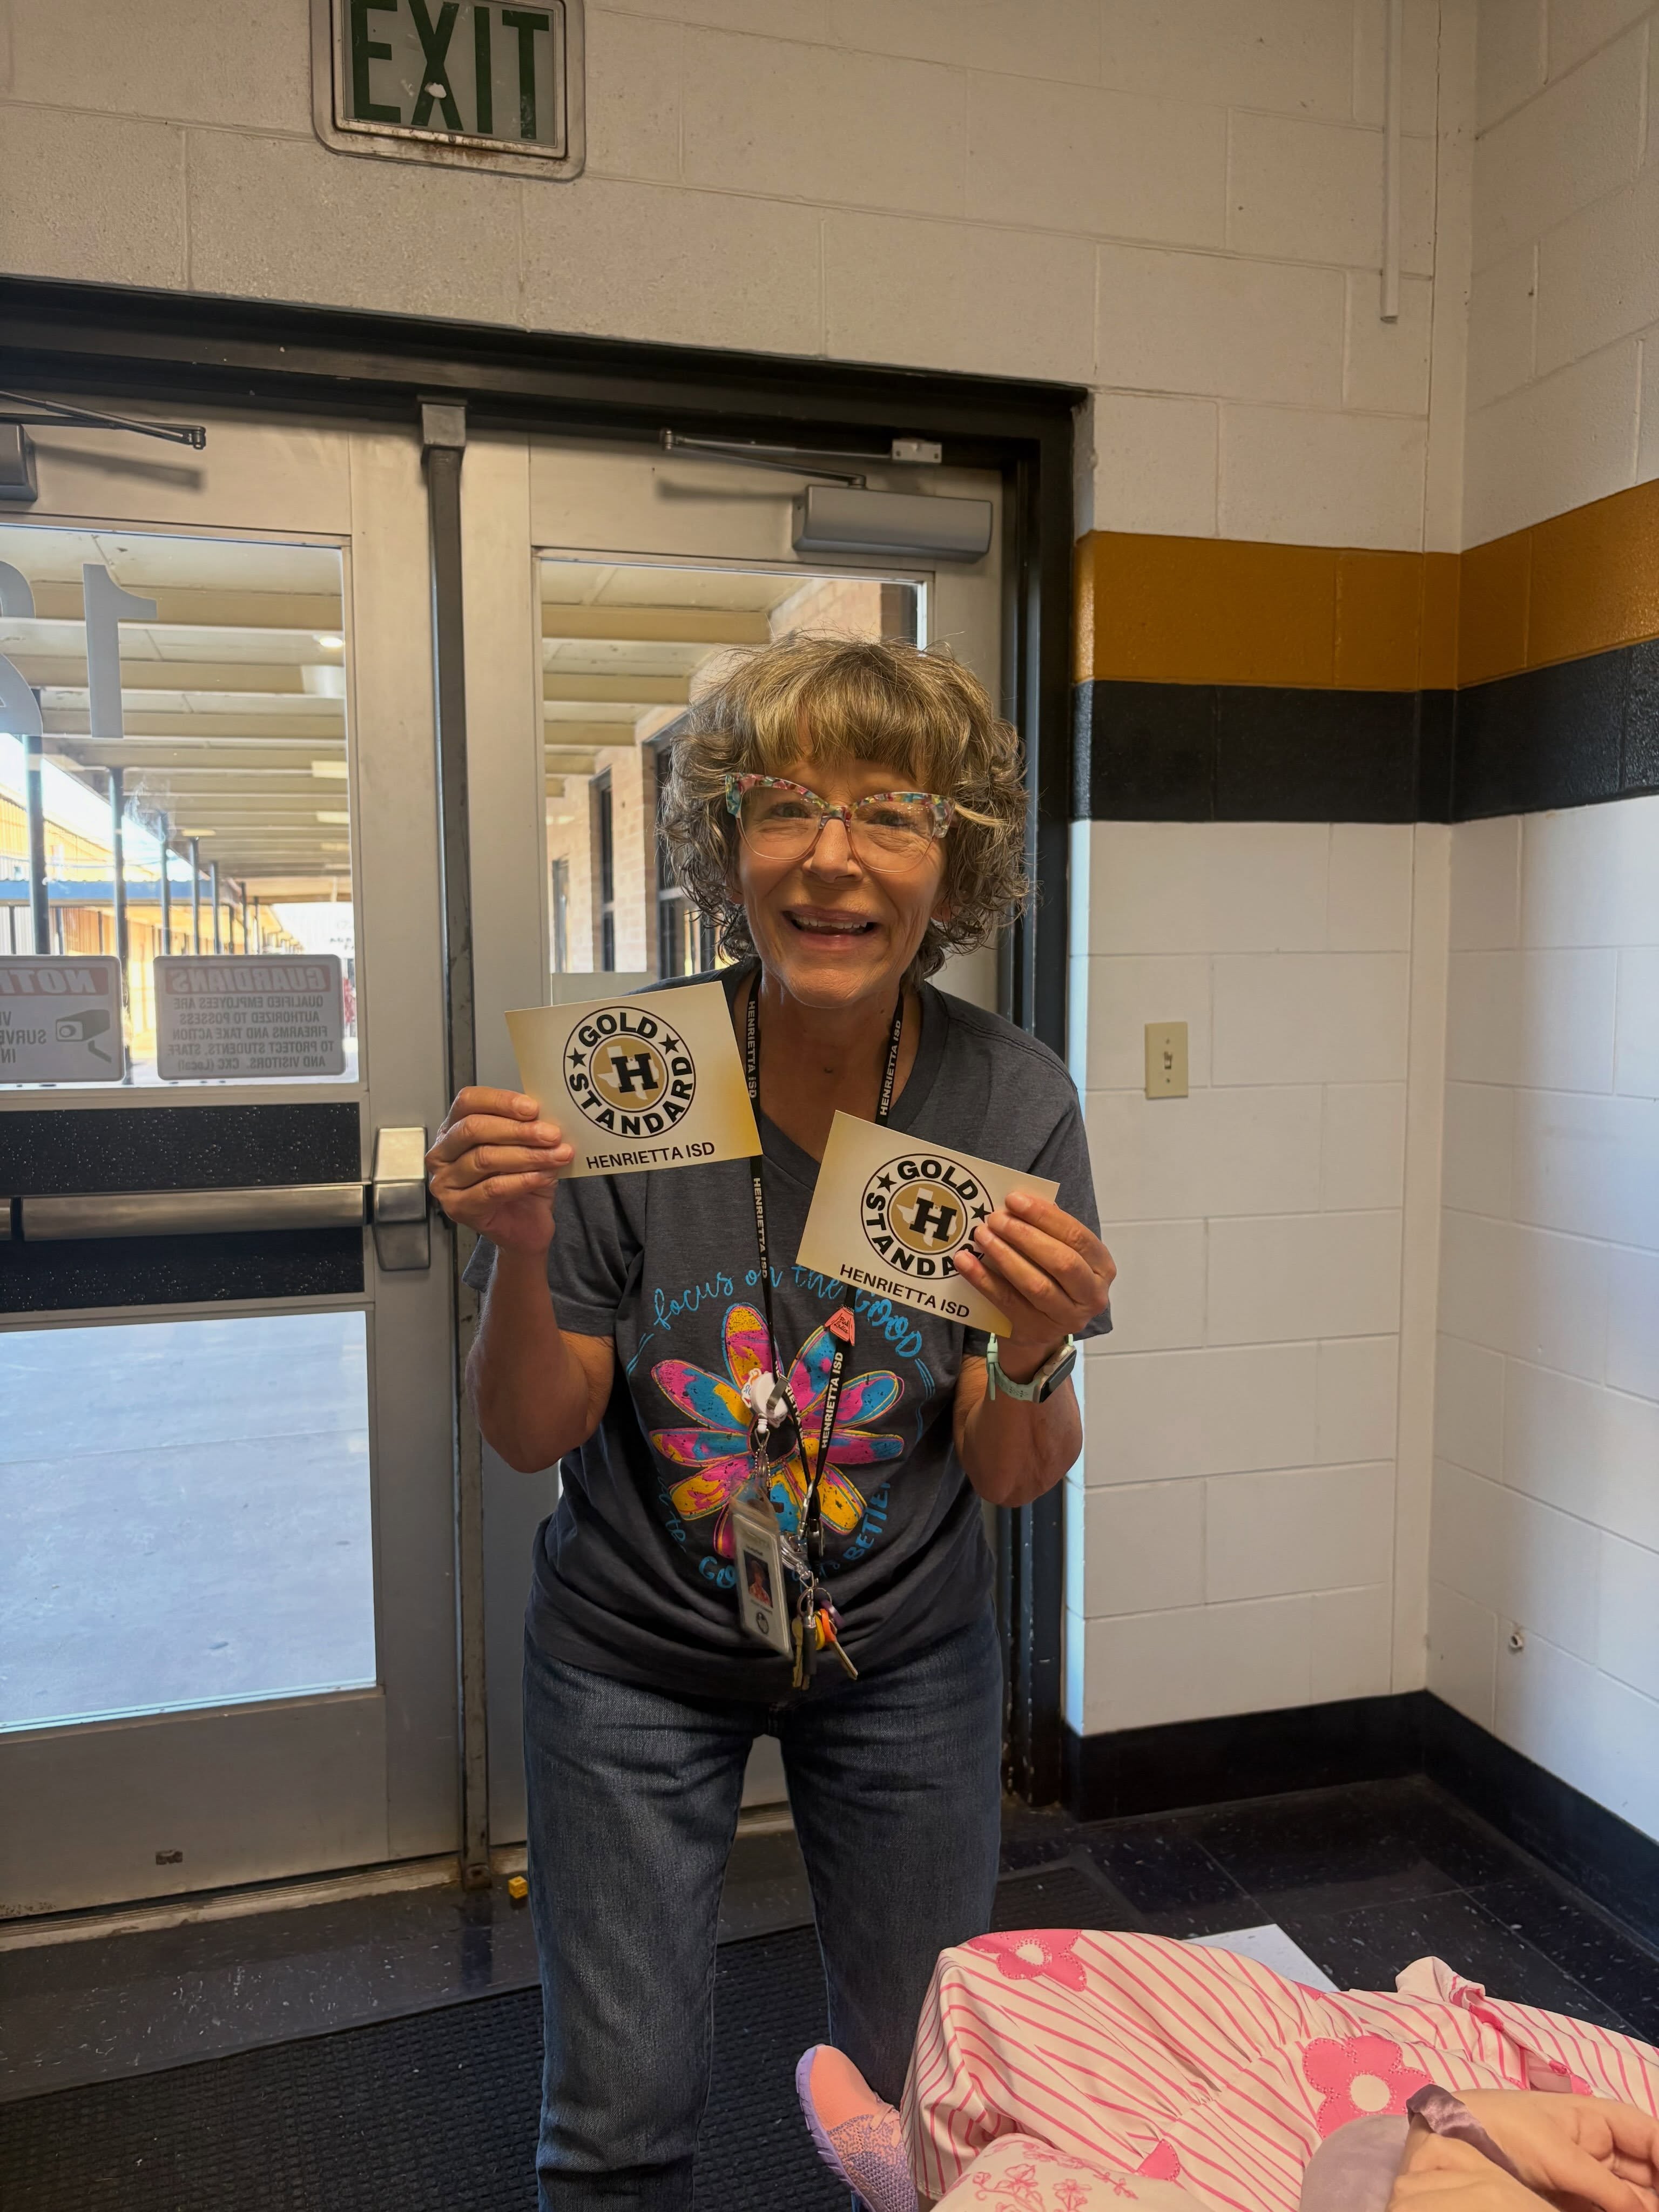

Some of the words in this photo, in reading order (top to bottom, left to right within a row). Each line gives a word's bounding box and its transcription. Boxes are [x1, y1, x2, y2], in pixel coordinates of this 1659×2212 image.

[350, 0, 549, 139] EXIT
[578, 1011, 658, 1047] GOLD
[747, 1000, 756, 1074] HENRIETTA
[610, 1053, 659, 1094] H
[748, 1076, 757, 1098] ISD
[880, 1042, 898, 1116] HENRIETTA
[893, 1020, 901, 1041] ISD
[569, 1056, 693, 1136] STANDARD
[586, 1145, 683, 1170] HENRIETTA
[686, 1142, 715, 1158] ISD
[896, 1159, 979, 1201] GOLD
[753, 1177, 766, 1253] HENRIETTA
[909, 1197, 957, 1243] H
[839, 1263, 937, 1309] HENRIETTA
[940, 1299, 970, 1318] ISD
[821, 1377, 840, 1448] HENRIETTA
[832, 1352, 844, 1374] ISD
